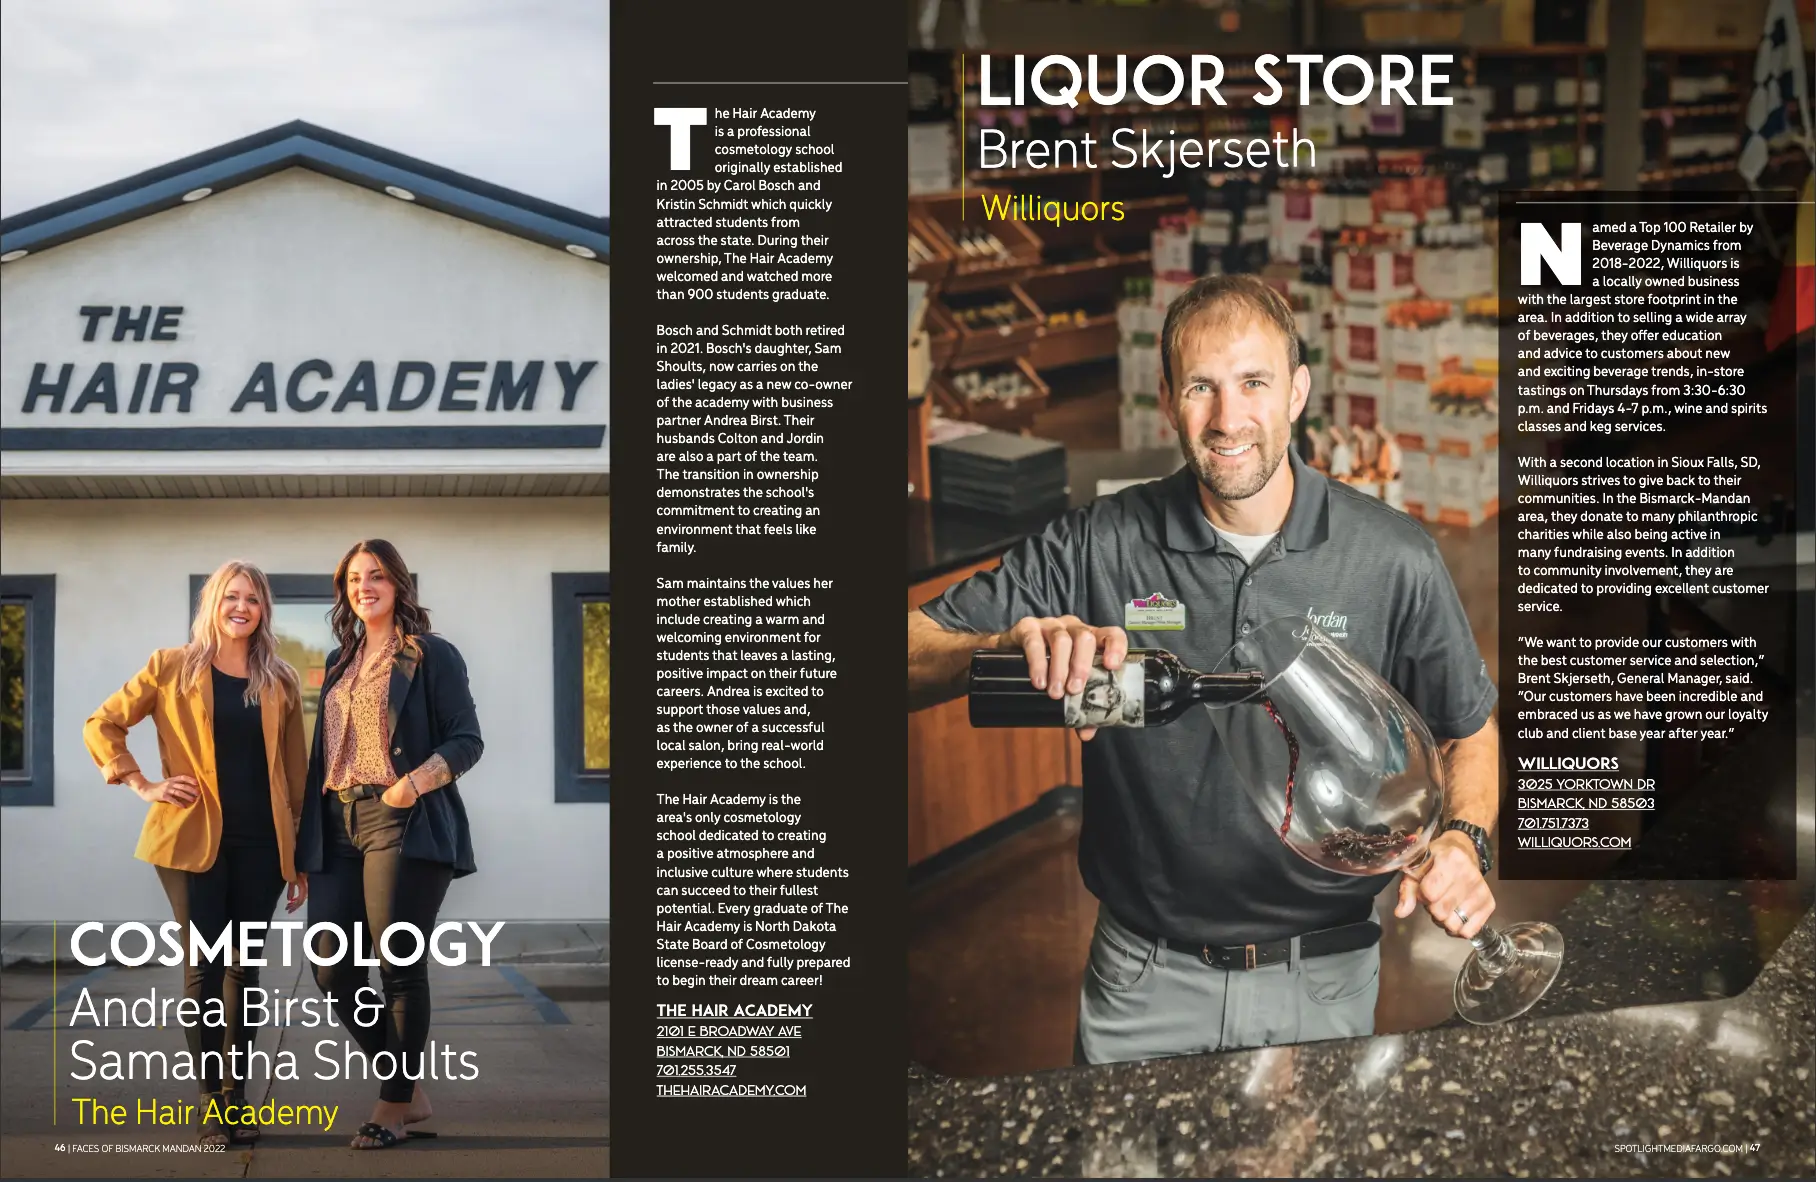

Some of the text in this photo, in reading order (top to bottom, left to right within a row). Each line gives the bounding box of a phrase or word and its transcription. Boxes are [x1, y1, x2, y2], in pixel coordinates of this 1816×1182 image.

[79, 305, 185, 343] THE
[21, 358, 600, 414] HAIR ACADEMY
